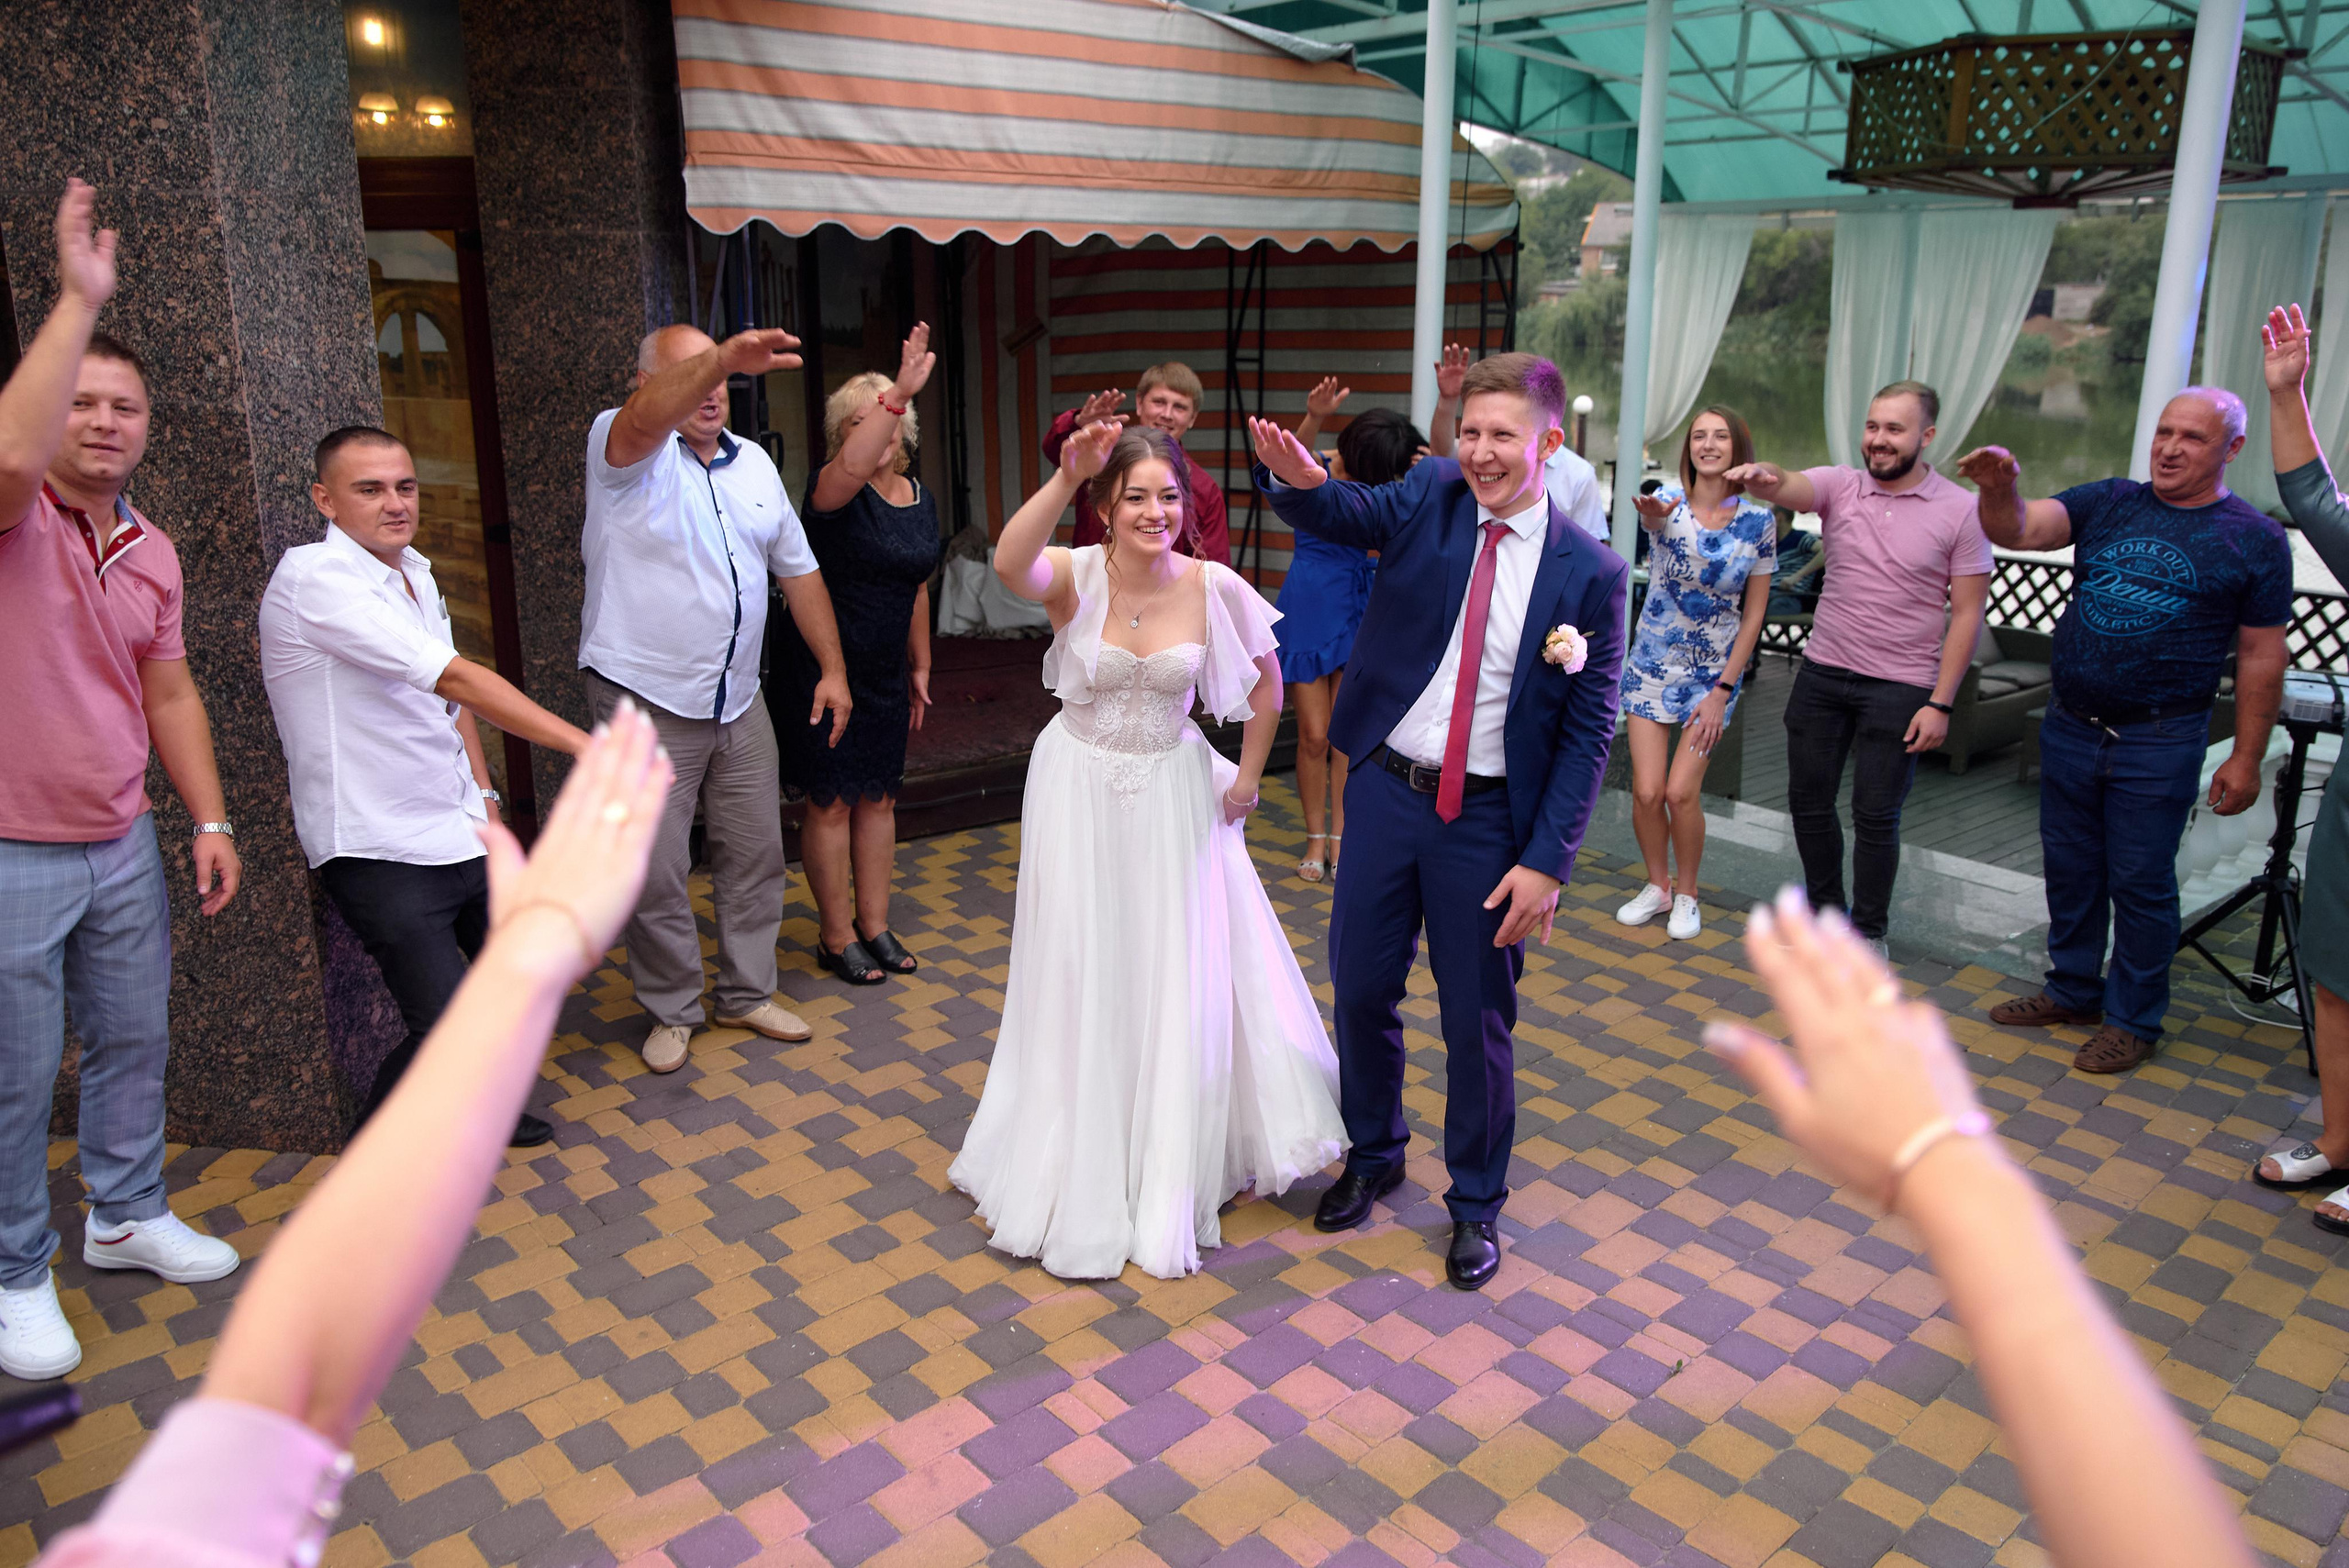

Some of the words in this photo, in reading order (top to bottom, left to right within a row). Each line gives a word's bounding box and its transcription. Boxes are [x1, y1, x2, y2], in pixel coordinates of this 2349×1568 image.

[2102, 542, 2161, 560] WORK
[2163, 551, 2189, 580] OUT
[2083, 567, 2188, 610] Denim
[2085, 602, 2152, 629] ATHLETIC
